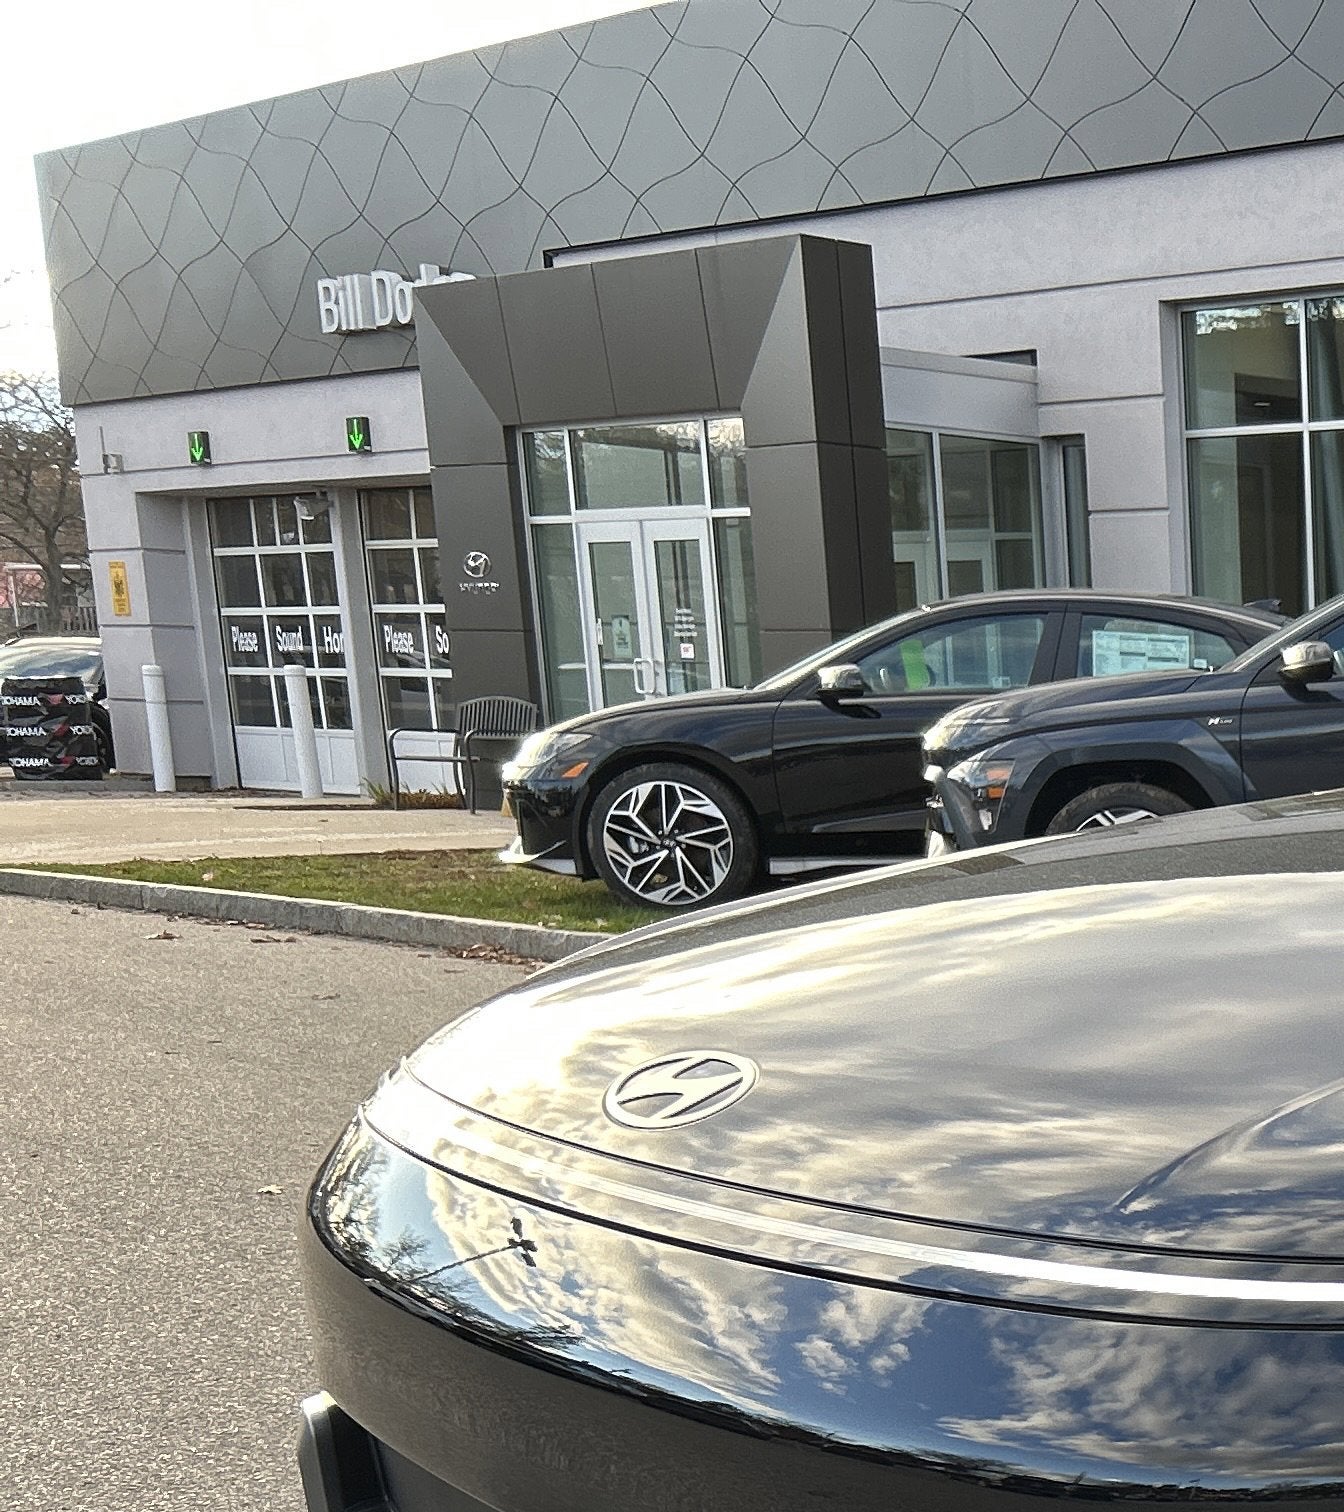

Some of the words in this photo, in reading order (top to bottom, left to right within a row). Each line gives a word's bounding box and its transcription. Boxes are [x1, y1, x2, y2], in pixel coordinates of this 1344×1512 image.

[317, 273, 368, 333] Bill
[231, 625, 259, 652] Please
[275, 625, 304, 652] Sound
[383, 624, 414, 653] Please
